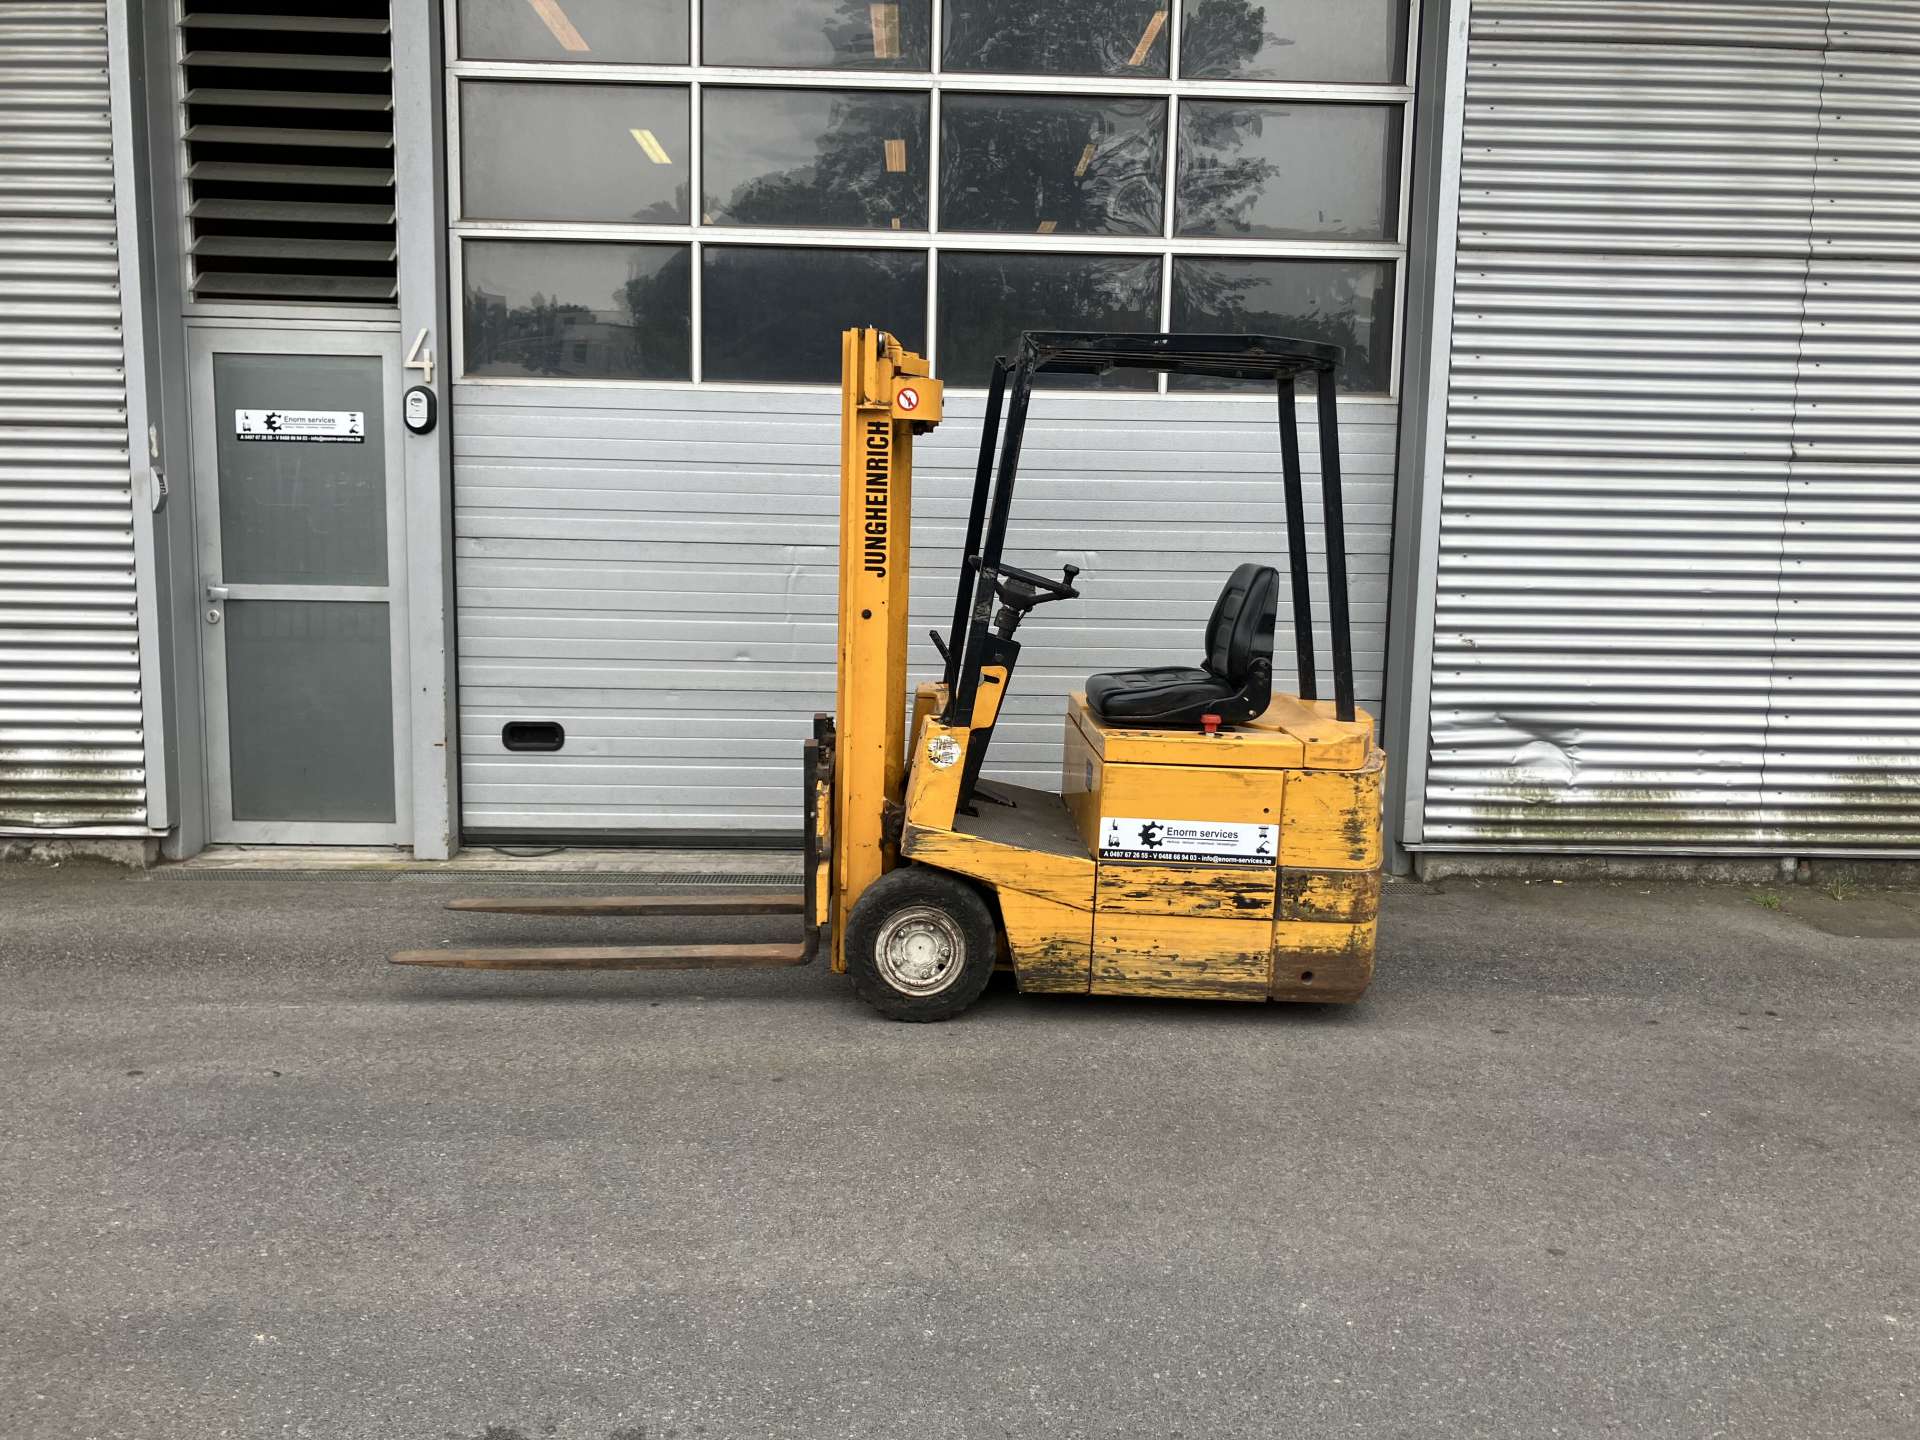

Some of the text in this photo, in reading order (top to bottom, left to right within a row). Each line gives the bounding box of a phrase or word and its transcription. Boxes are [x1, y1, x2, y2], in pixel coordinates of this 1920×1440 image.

[403, 327, 433, 383] 4
[284, 415, 306, 423] Enorm
[864, 421, 889, 578] JUNGHEINRICH
[1167, 827, 1239, 839] Enorm services
